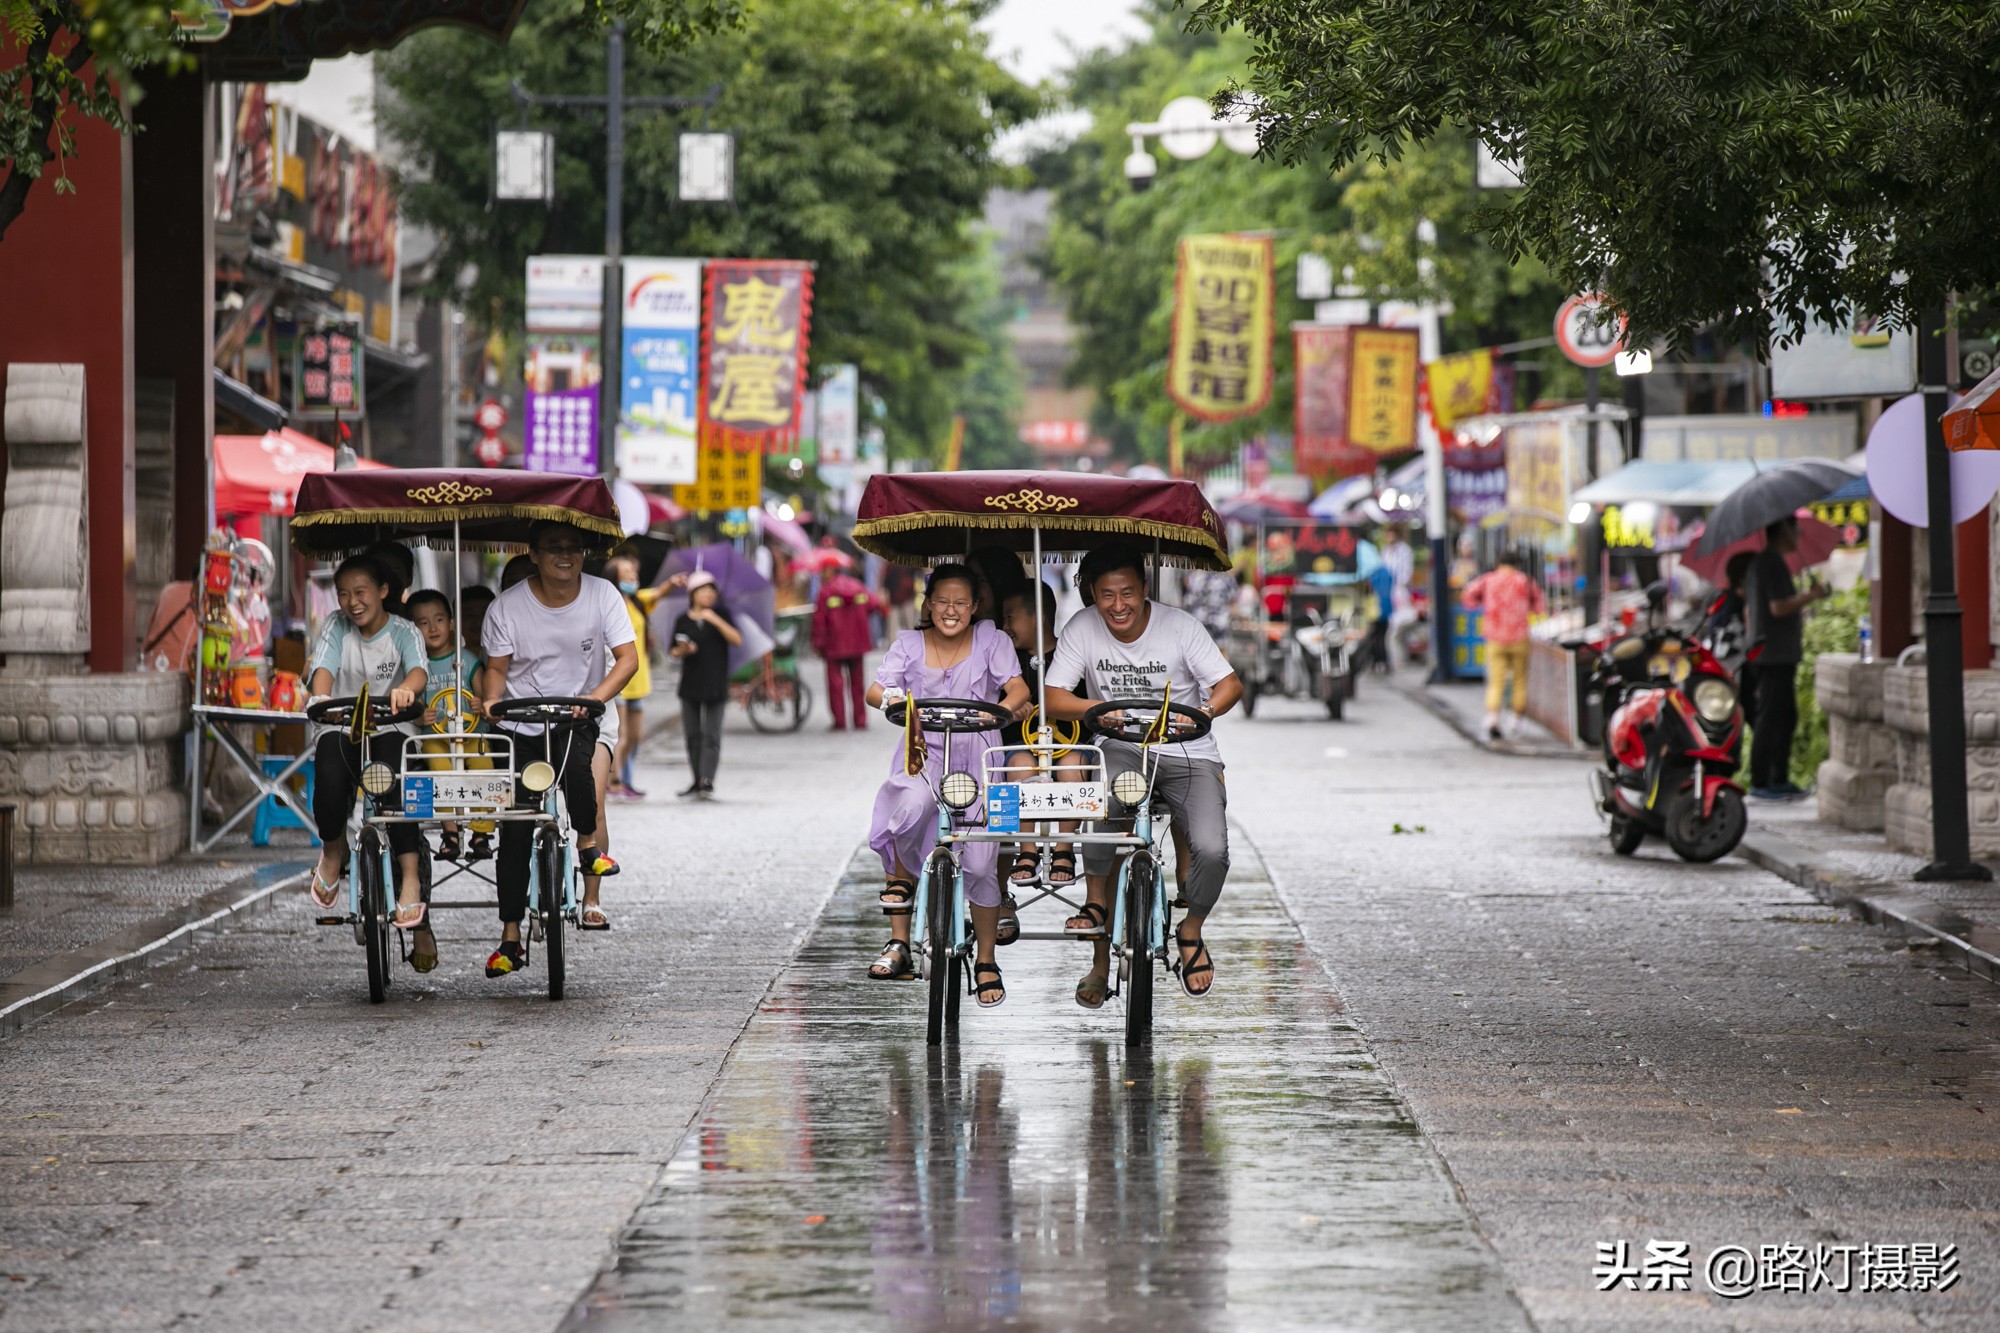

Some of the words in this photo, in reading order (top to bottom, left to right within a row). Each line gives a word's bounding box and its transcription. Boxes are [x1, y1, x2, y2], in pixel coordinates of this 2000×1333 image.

[709, 276, 797, 426] 鬼屋
[1096, 659, 1167, 674] Abercrombie
[1111, 676, 1121, 686] &
[1122, 674, 1152, 687] Fitch
[487, 782, 503, 792] 88
[1079, 787, 1095, 798] 92
